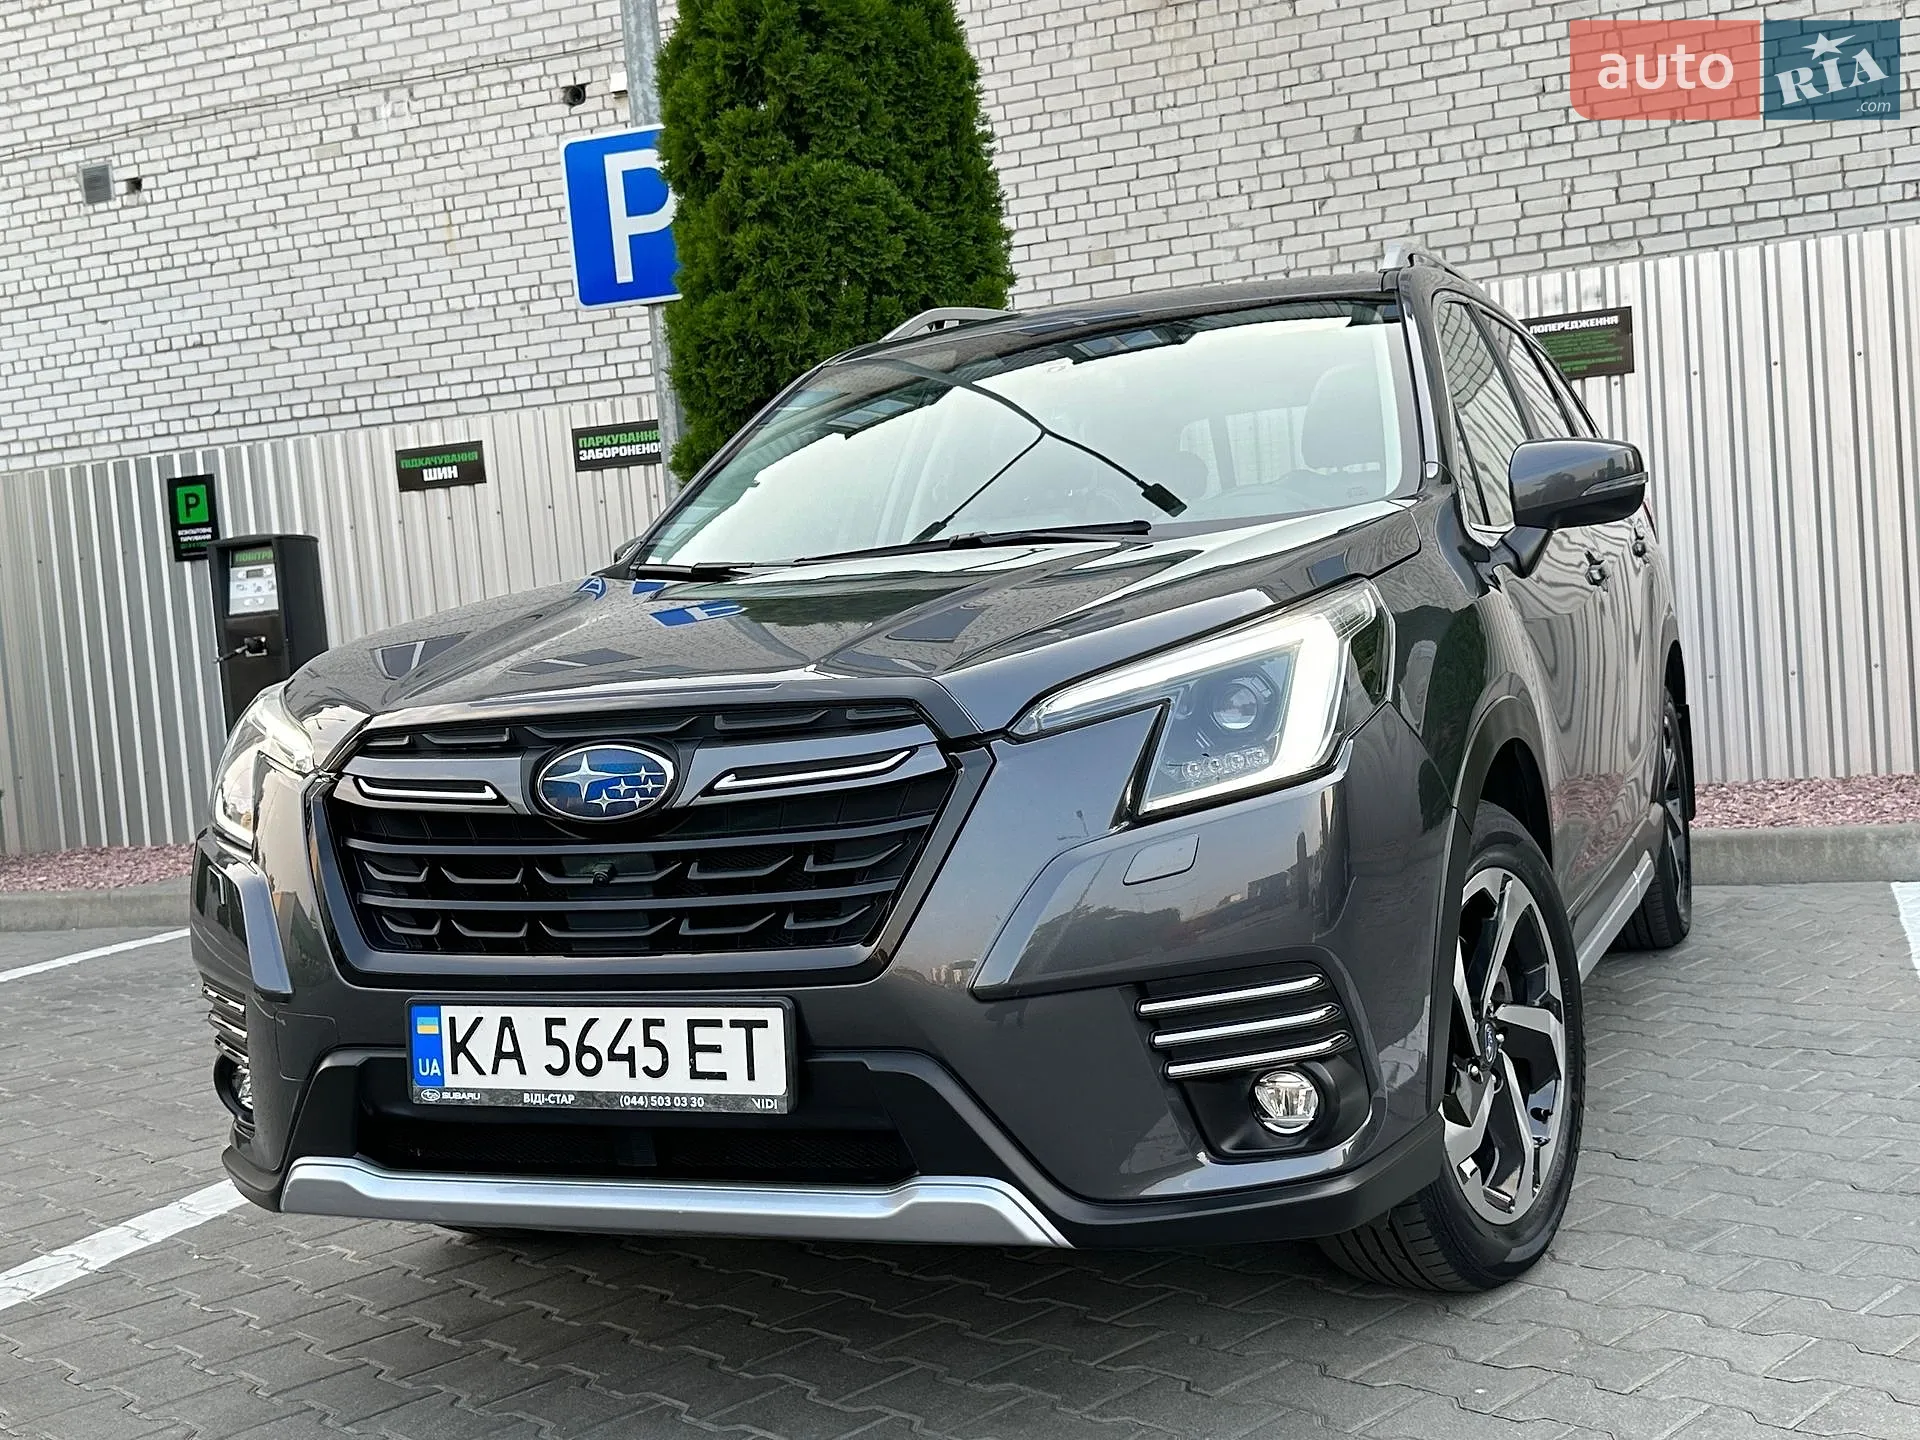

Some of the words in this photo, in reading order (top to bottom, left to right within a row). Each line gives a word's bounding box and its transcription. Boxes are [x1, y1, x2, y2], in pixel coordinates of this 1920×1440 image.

[604, 149, 680, 283] P
[578, 430, 660, 448] ПАРКУВАННЯ
[400, 451, 478, 469] ПІДКАЧУВАННЯ
[579, 442, 662, 461] ЗАБОРОНЕНО!
[423, 465, 458, 482] ШИН
[184, 492, 201, 518] P
[447, 1016, 528, 1078] KA
[544, 1017, 669, 1079] 5645
[687, 1018, 769, 1082] ET
[418, 1057, 441, 1077] UA
[441, 1091, 481, 1101] SUBARU
[523, 1092, 575, 1106] ВІДІ-СТАР
[619, 1094, 649, 1109] (044)
[650, 1095, 672, 1108] 503
[673, 1096, 689, 1109] 03
[690, 1096, 705, 1109] 30
